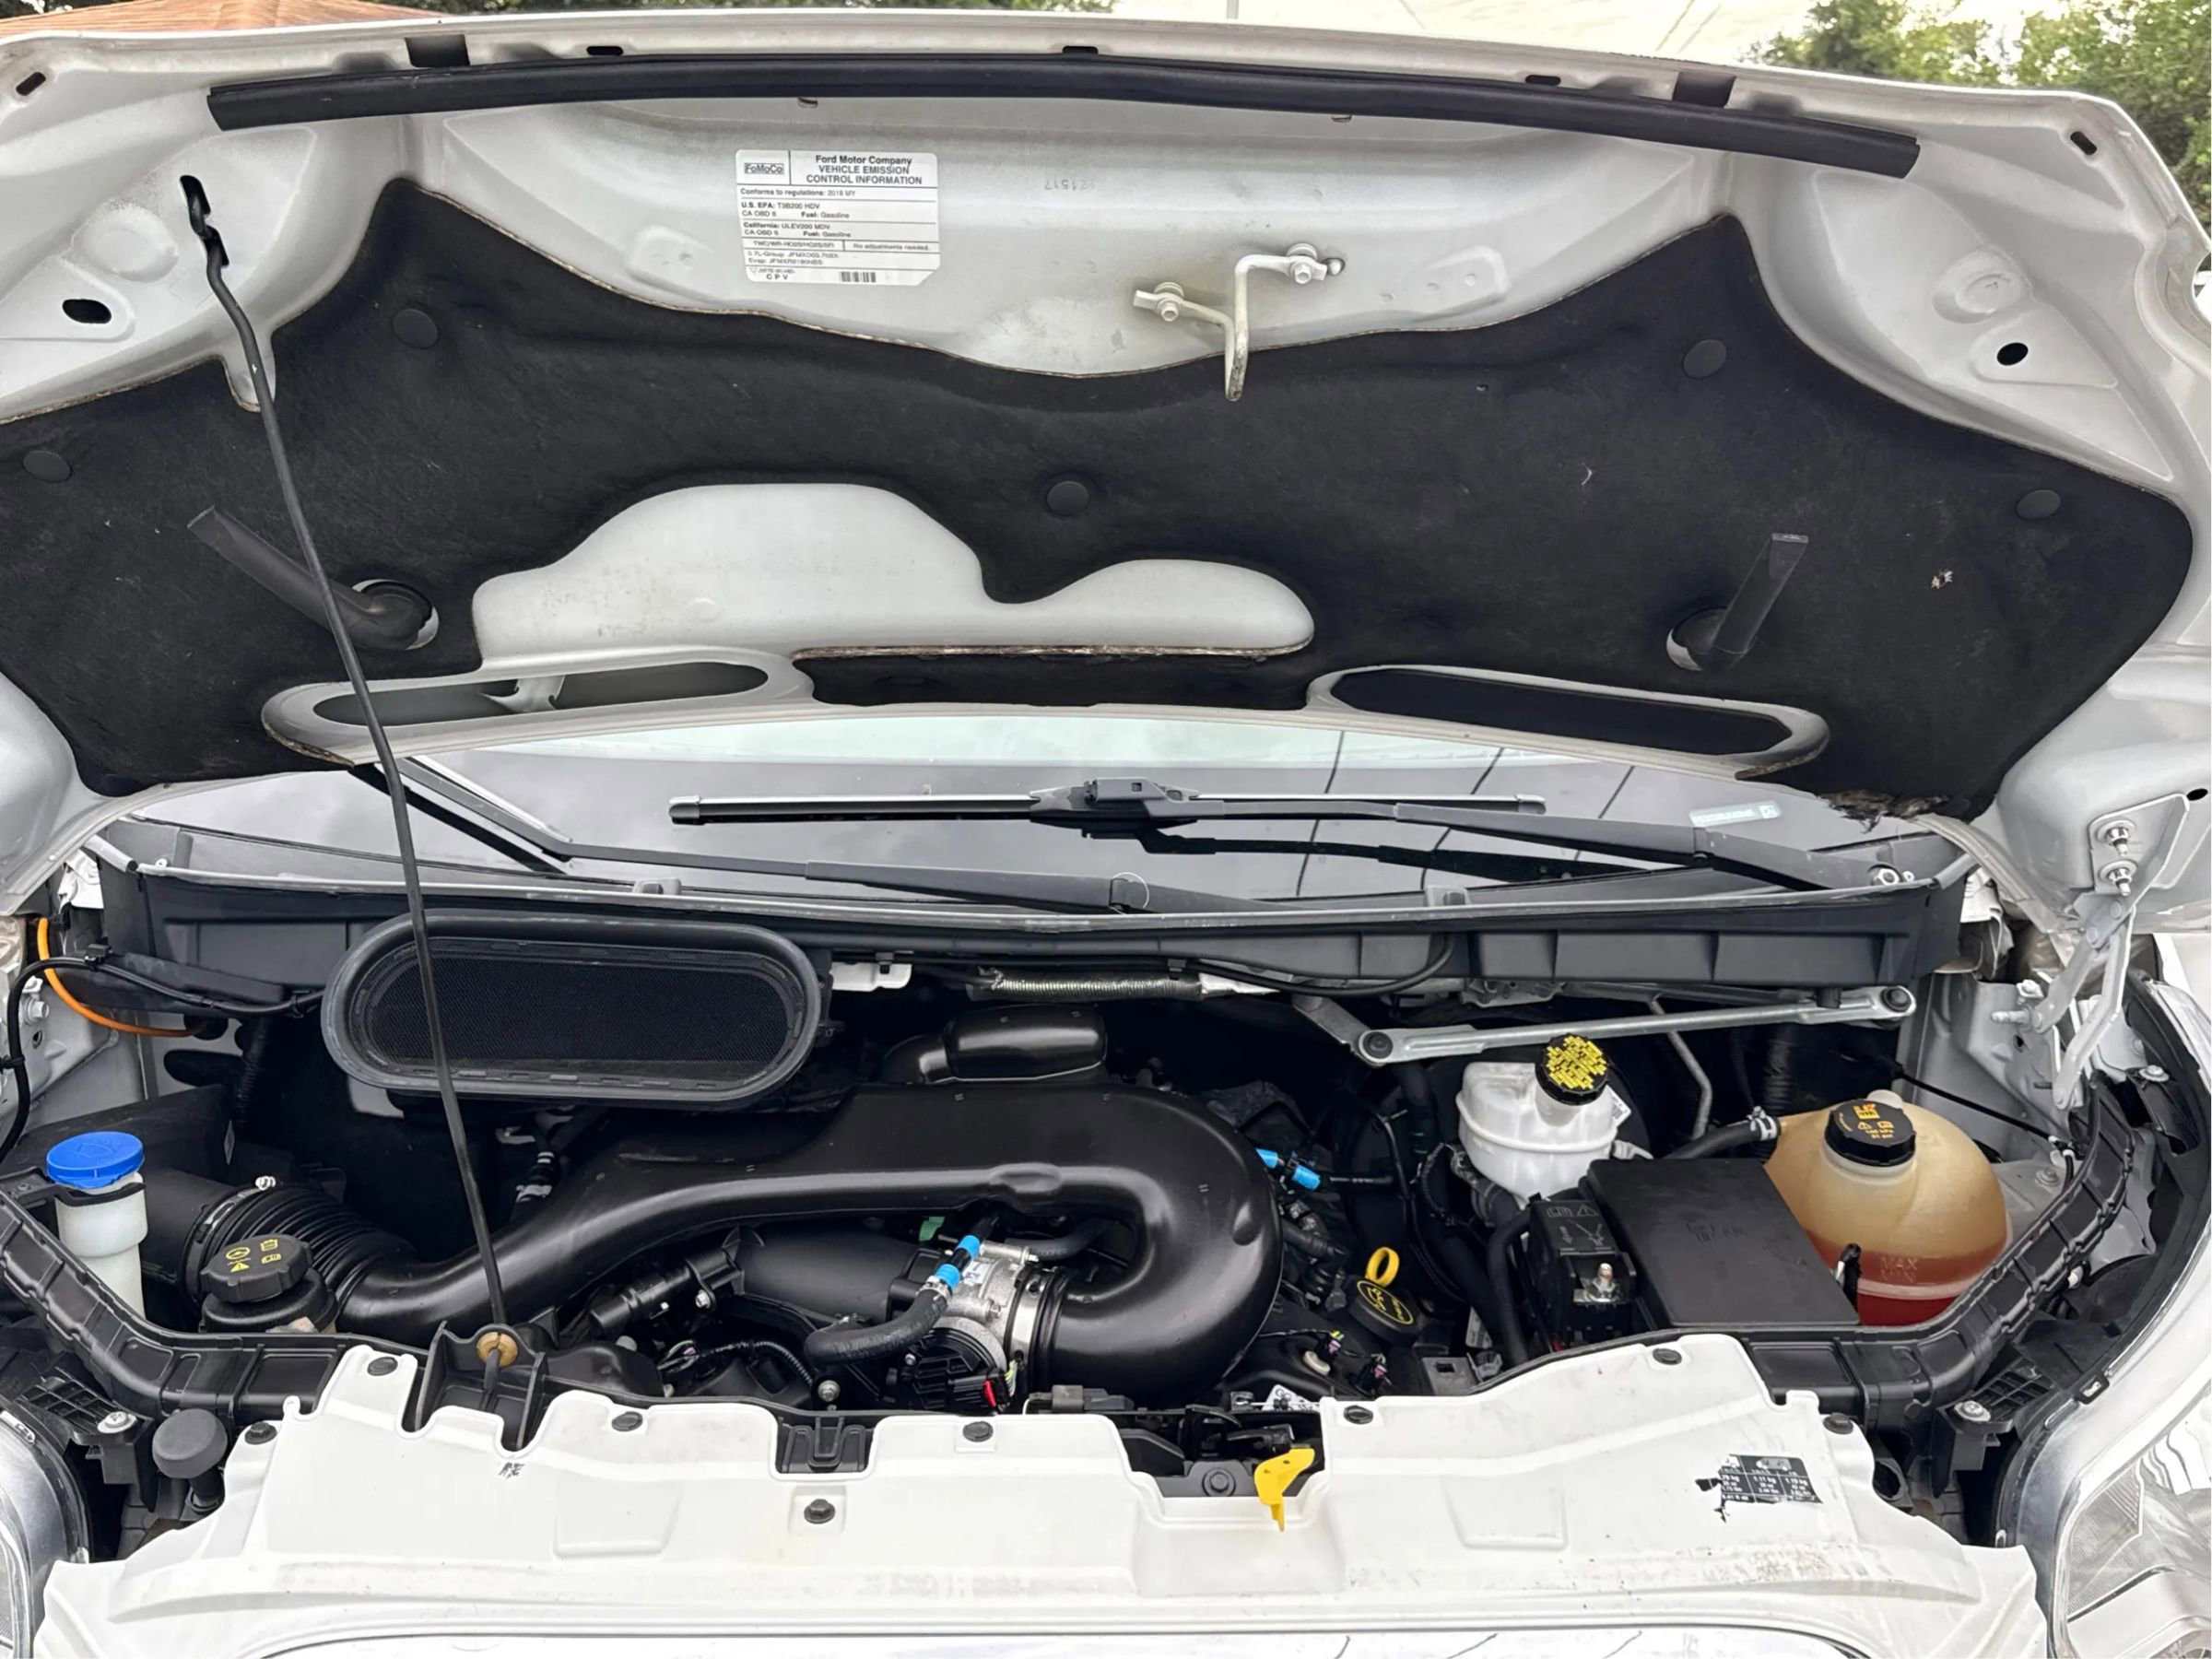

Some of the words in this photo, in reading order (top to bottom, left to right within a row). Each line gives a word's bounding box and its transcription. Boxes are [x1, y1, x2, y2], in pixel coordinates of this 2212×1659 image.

[815, 155, 837, 163] Ford
[840, 155, 866, 164] Motor
[868, 156, 912, 166] Company
[745, 163, 783, 174] FoMoCo
[818, 165, 860, 174] VEHICLE
[863, 165, 910, 175] EMISSION
[806, 174, 853, 183] CONTROL
[855, 175, 923, 184] INFORMATION
[1880, 1256, 1918, 1270] MAX
